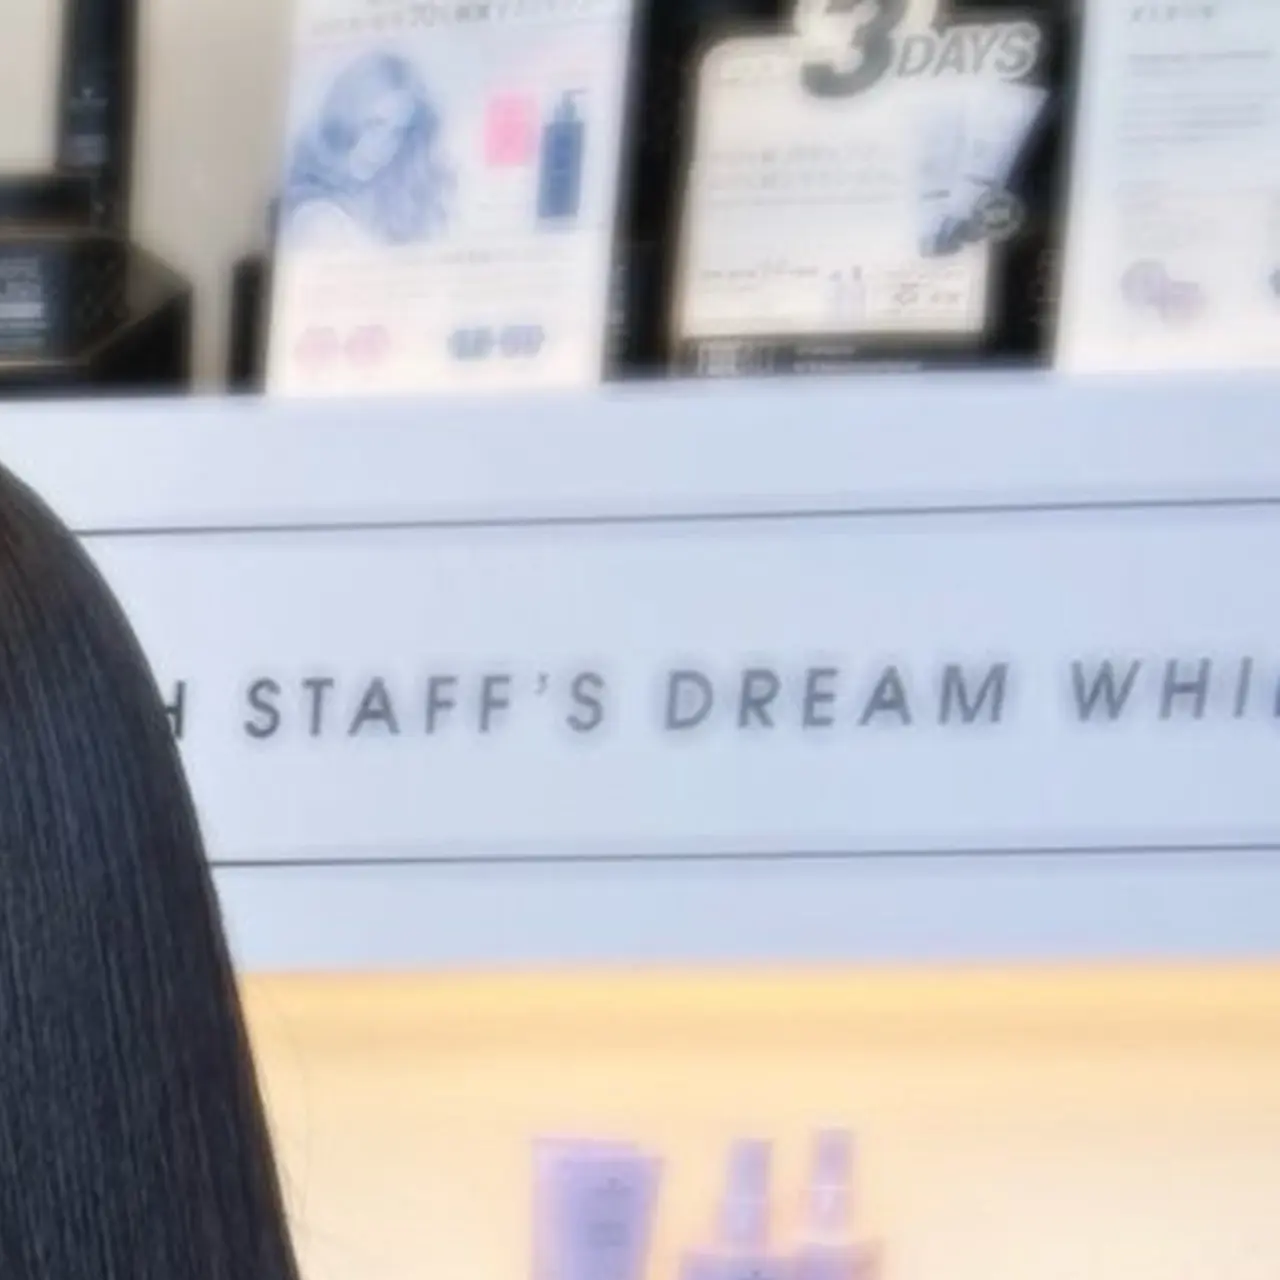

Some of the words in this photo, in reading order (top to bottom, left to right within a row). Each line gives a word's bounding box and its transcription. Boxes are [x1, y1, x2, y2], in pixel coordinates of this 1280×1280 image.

[894, 24, 1038, 79] DAYS
[243, 672, 605, 740] STAFF'S
[665, 662, 1009, 731] DREAM
[1070, 656, 1280, 721] WHI
